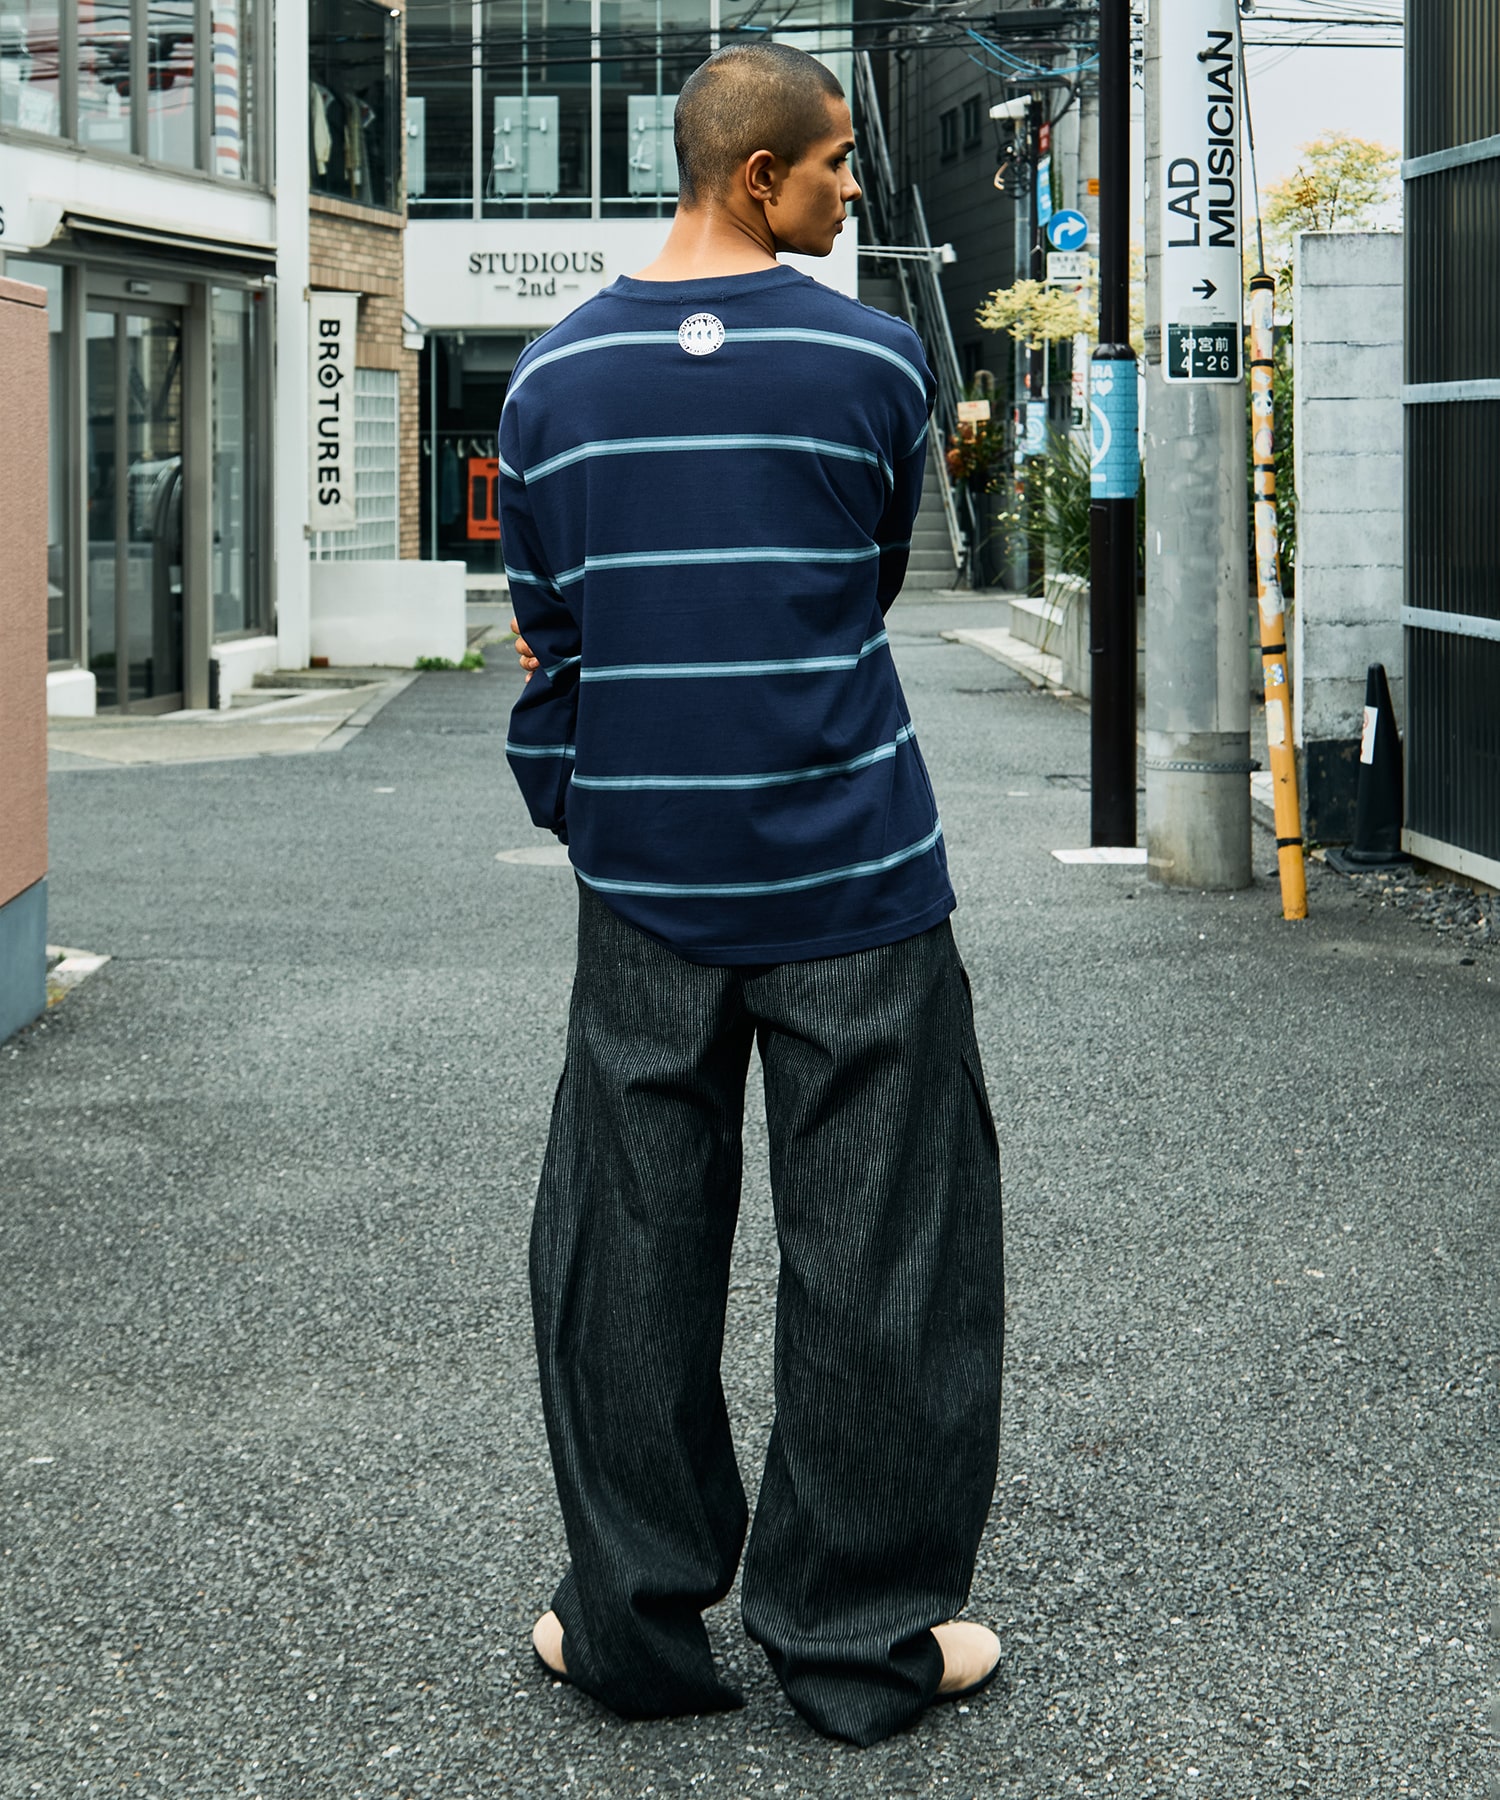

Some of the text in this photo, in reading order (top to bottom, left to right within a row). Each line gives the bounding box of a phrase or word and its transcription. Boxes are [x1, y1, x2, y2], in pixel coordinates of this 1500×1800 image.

[1207, 30, 1236, 248] MUSICIAN
[1167, 158, 1200, 248] LAD
[468, 252, 604, 274] STUDIOUS
[1180, 336, 1228, 353] 神宮前
[1180, 355, 1230, 371] 4-26
